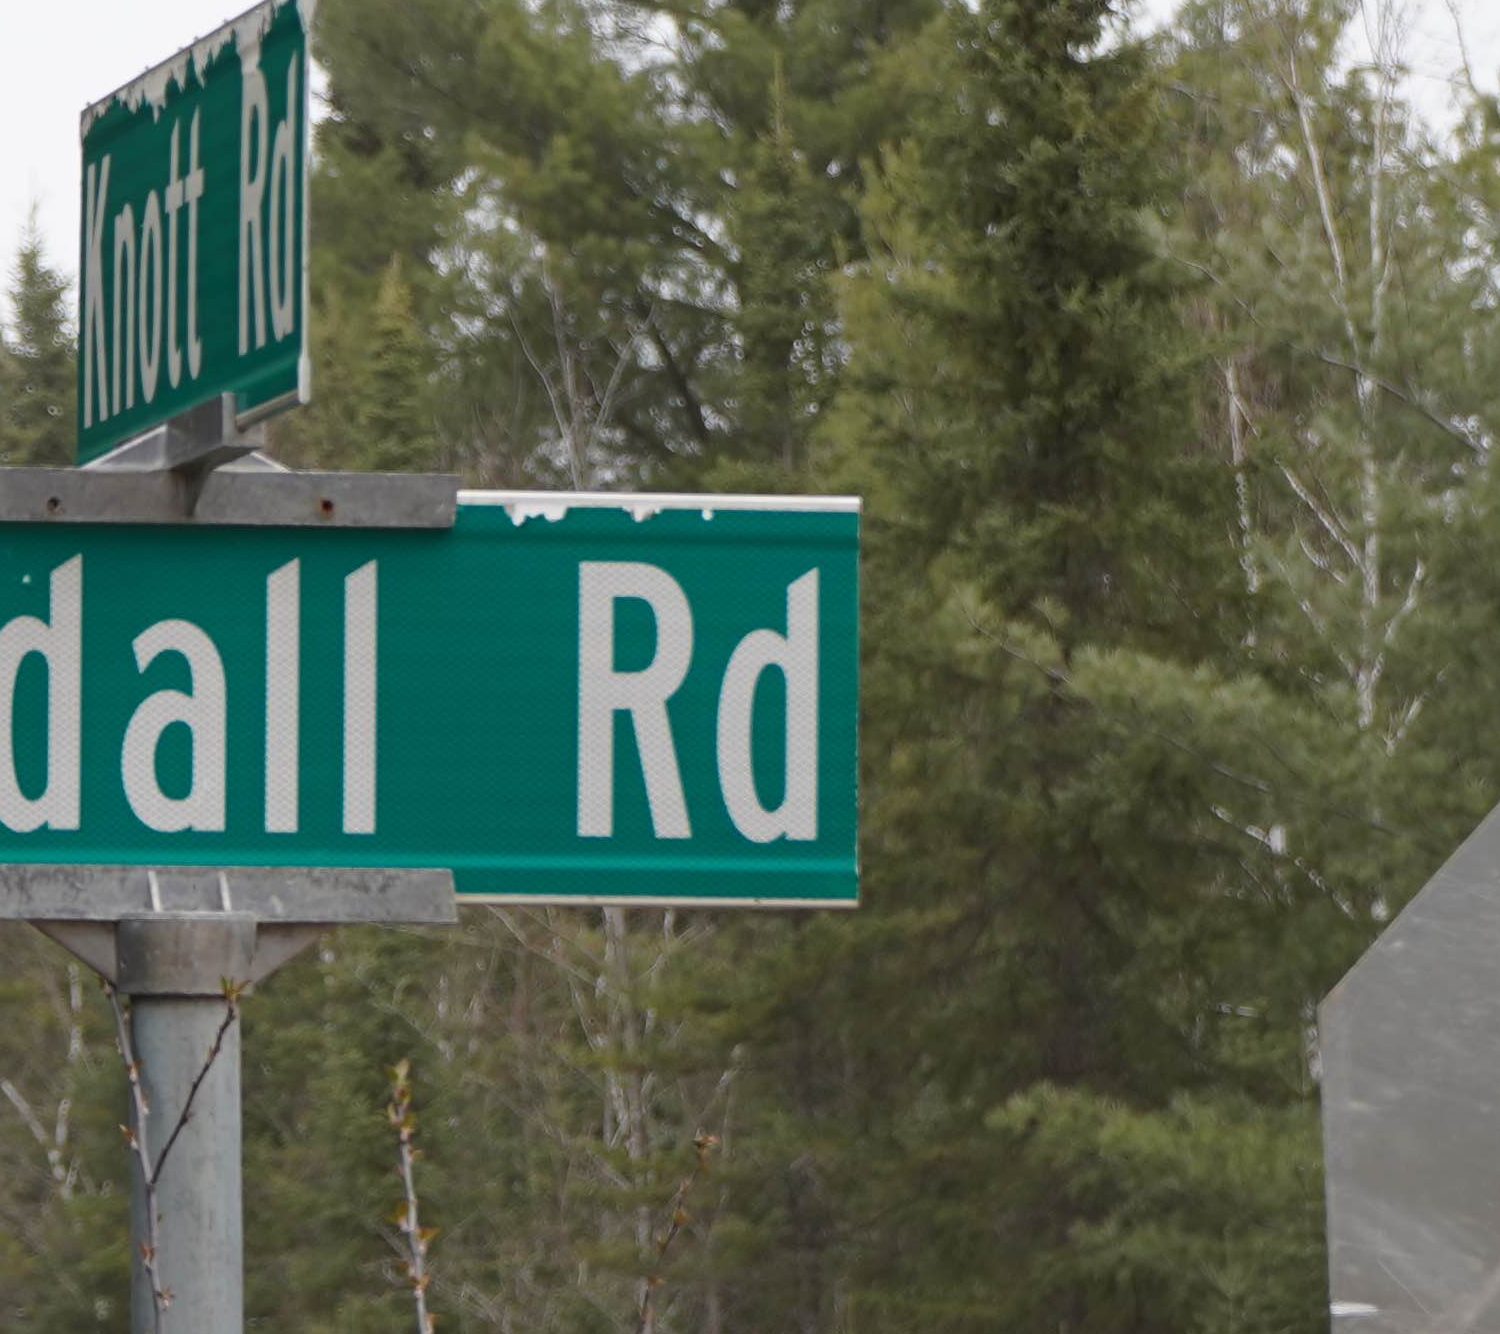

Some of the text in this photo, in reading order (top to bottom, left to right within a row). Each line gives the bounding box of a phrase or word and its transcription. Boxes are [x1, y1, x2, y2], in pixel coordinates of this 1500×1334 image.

[85, 51, 298, 428] Knott Rd
[576, 560, 820, 842] Rd
